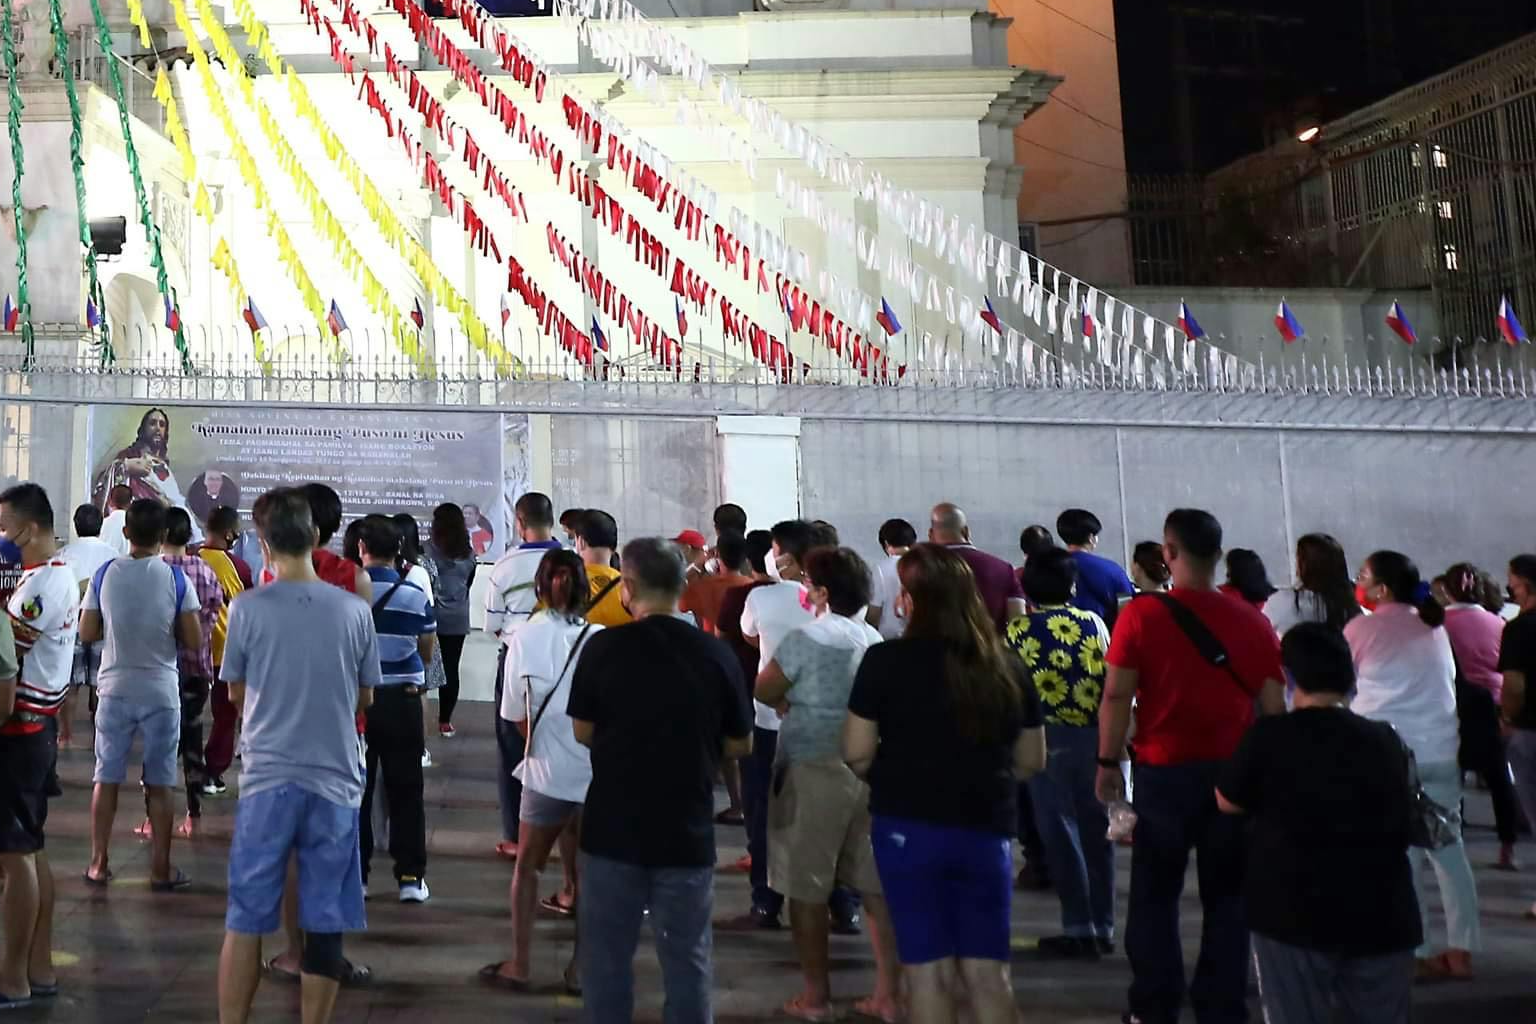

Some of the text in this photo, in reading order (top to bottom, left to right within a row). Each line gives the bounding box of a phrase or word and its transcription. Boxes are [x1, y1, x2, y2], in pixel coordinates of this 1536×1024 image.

[346, 426, 388, 440] Puso
[392, 428, 408, 439] ni
[413, 427, 465, 443] Hesus
[318, 440, 353, 449] PAMILYA
[316, 449, 345, 458] TUNGO
[341, 497, 372, 505] HARLES
[373, 498, 394, 506] JOHN
